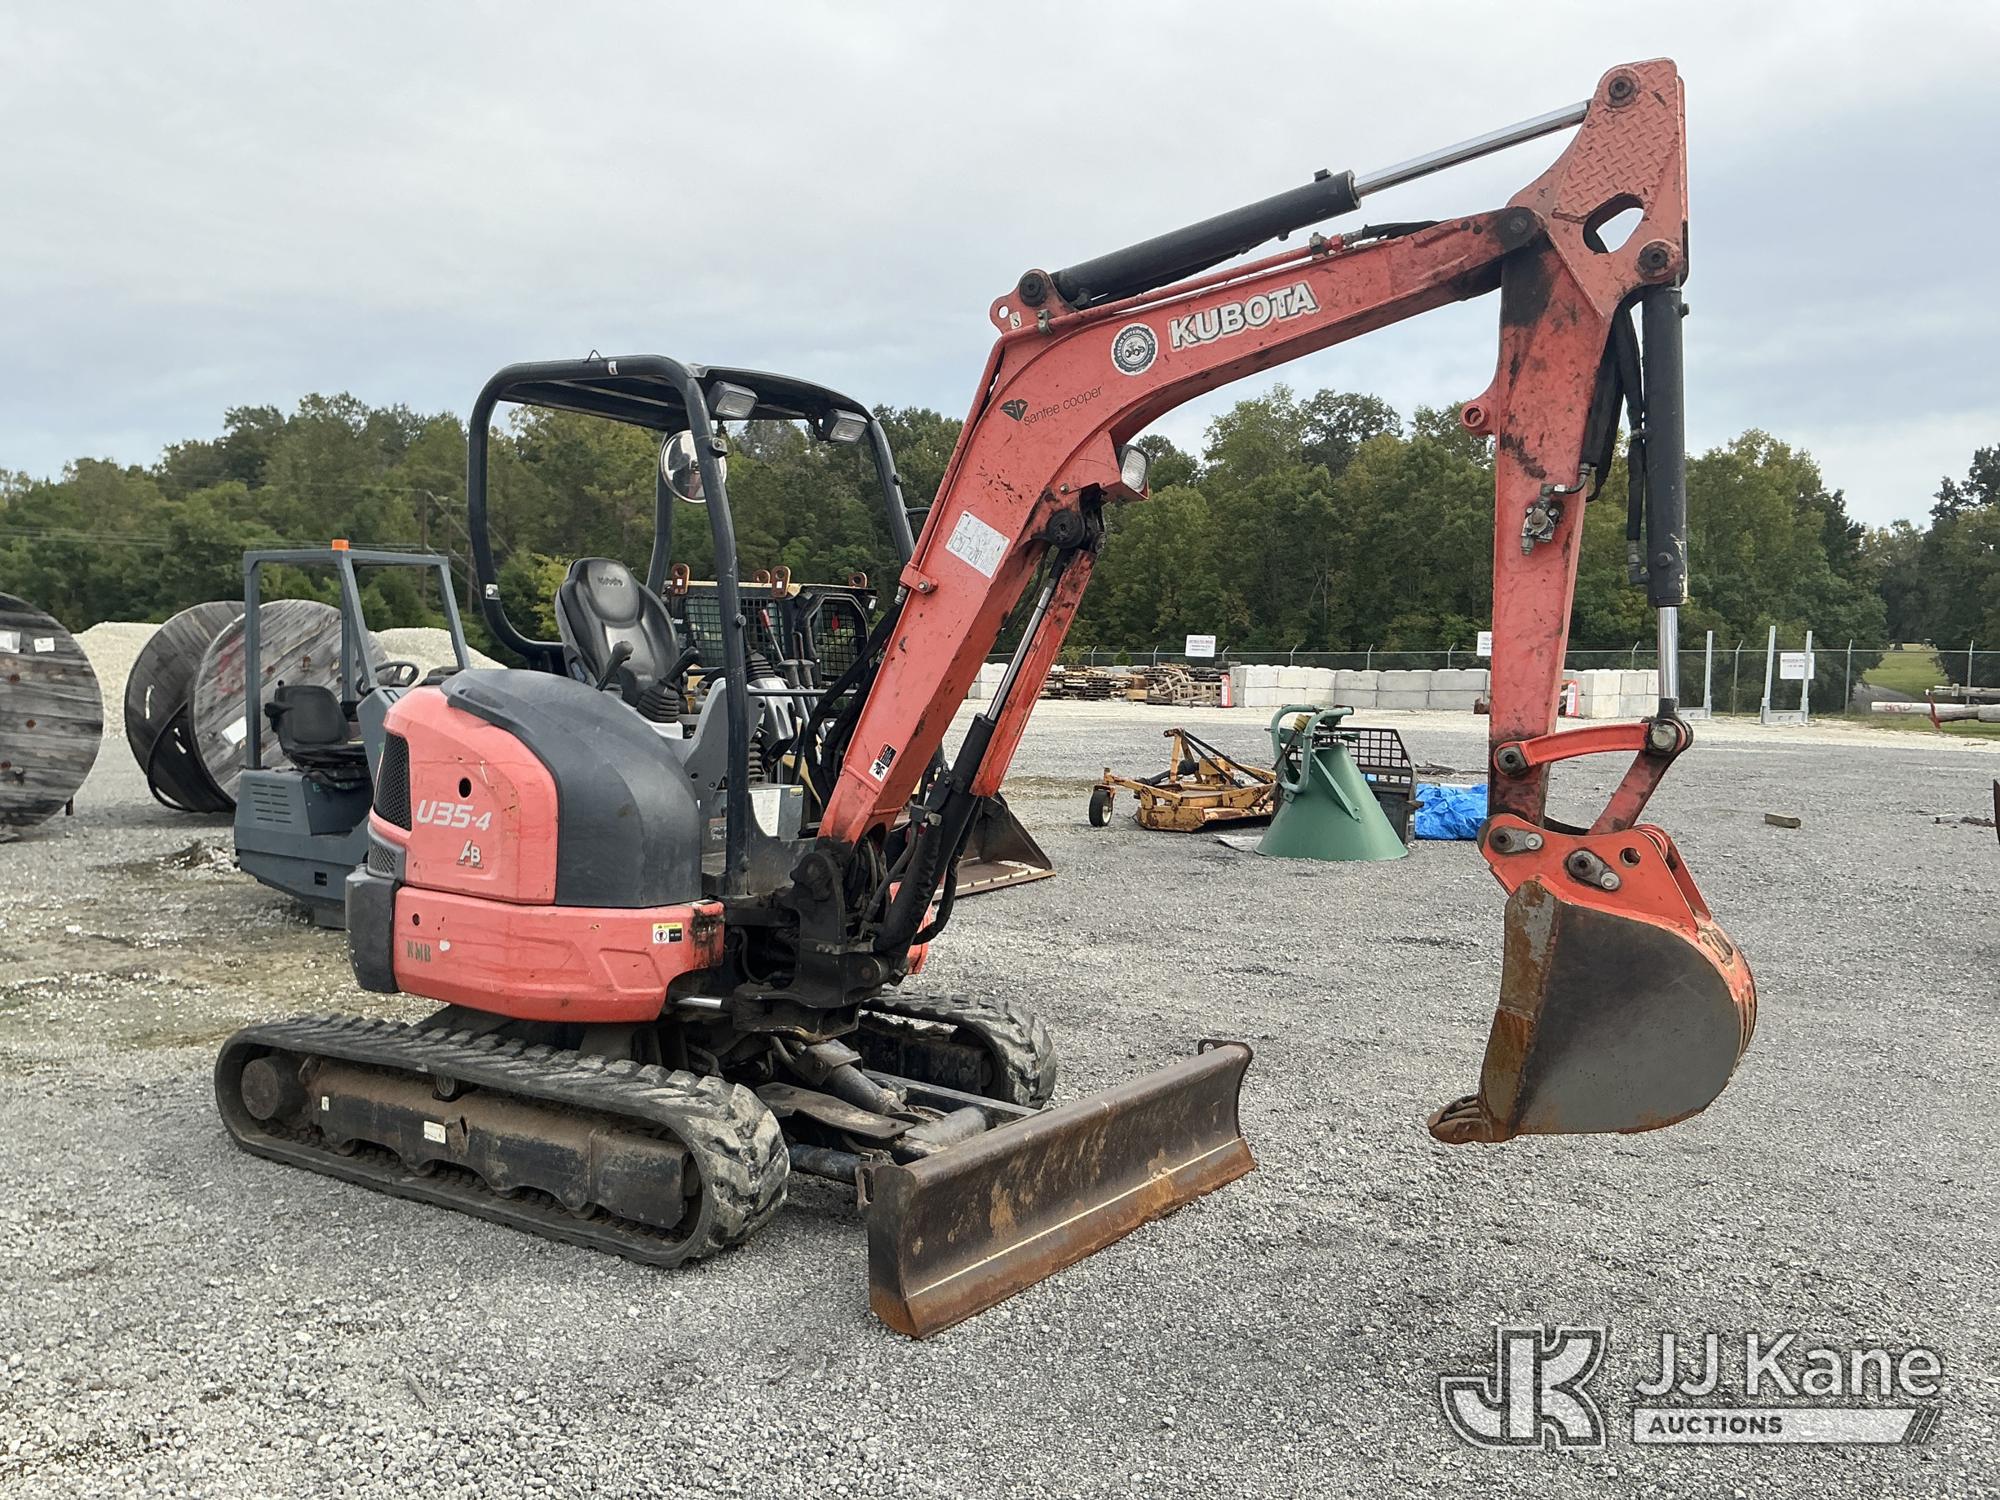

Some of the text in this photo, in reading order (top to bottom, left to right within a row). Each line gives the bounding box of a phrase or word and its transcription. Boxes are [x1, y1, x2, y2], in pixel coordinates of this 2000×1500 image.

[1170, 282, 1319, 348] KUBOTA
[1024, 386, 1102, 426] santee cooper
[416, 799, 492, 831] U35-4
